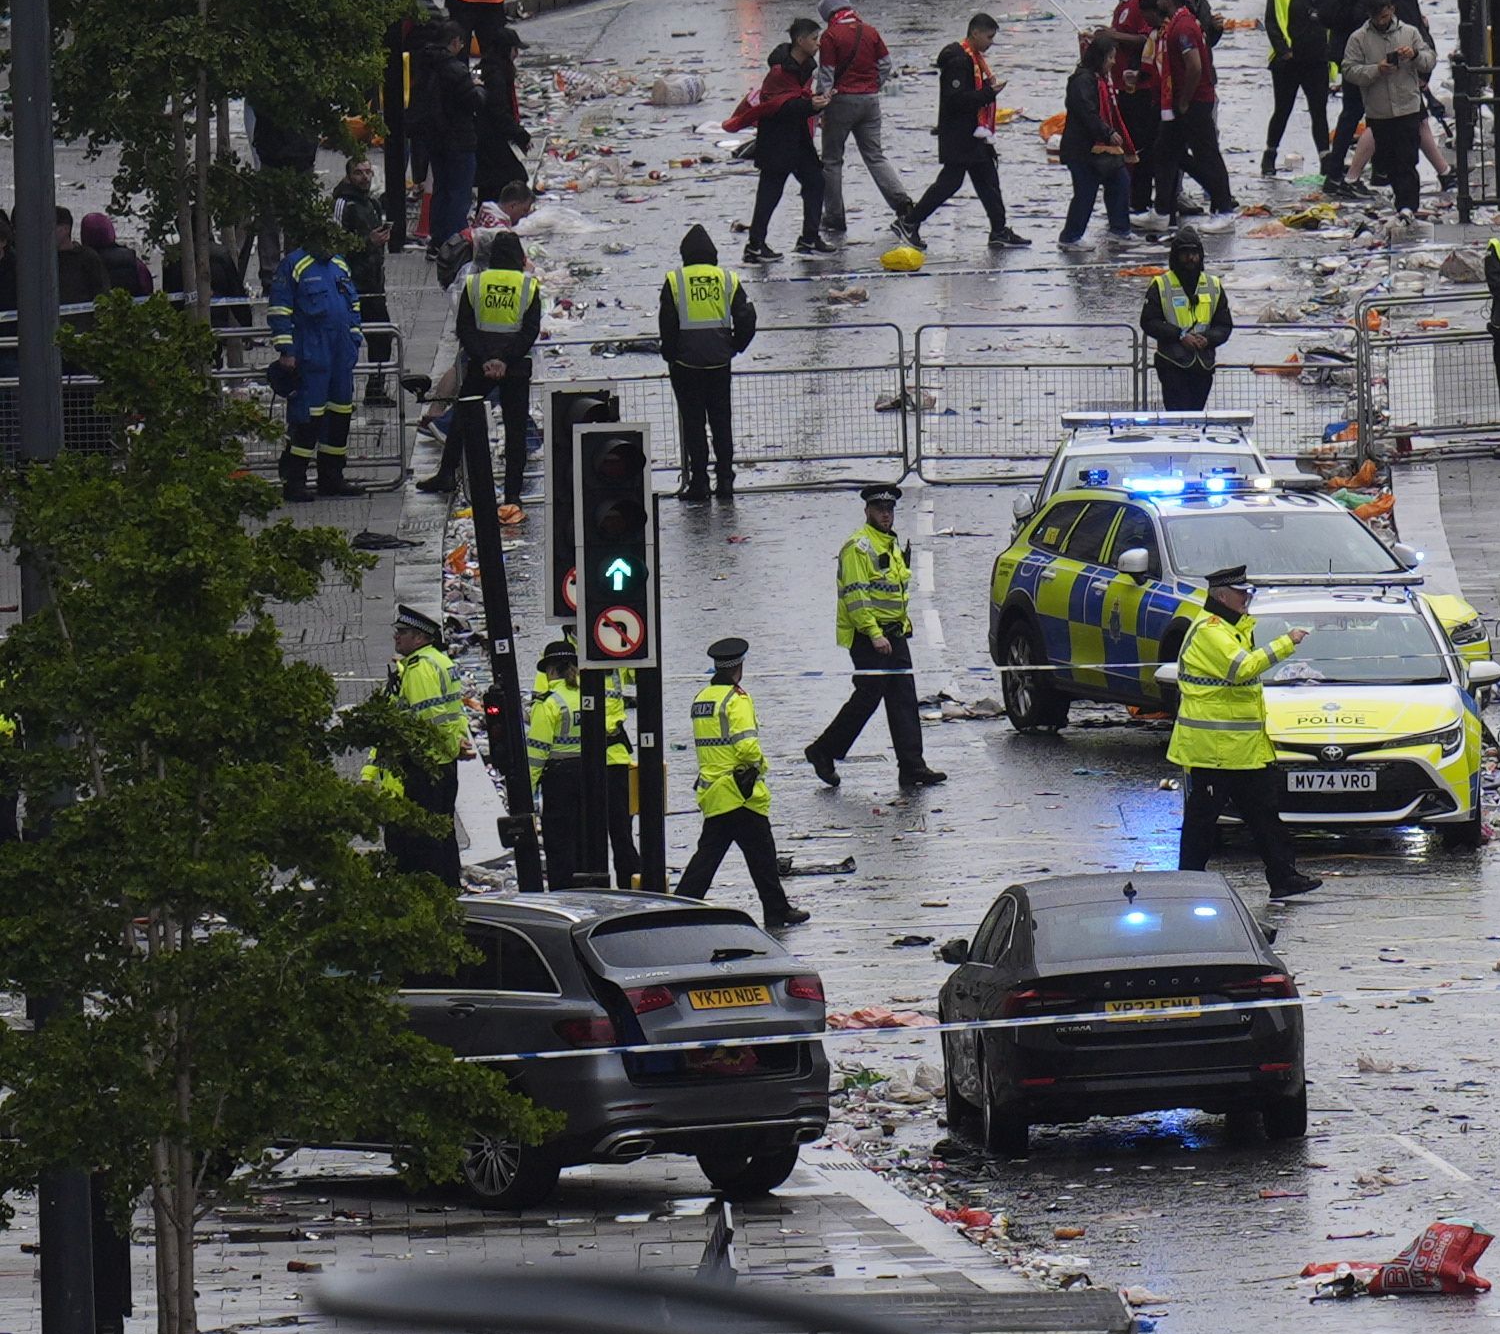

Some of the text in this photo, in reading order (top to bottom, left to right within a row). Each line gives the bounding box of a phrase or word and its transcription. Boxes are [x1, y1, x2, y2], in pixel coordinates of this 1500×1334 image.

[485, 294, 514, 310] GM44
[499, 642, 506, 652] 5
[1297, 716, 1356, 726] POLICE
[1295, 774, 1370, 788] MV74 VRO
[694, 987, 763, 1007] YK70 NDE
